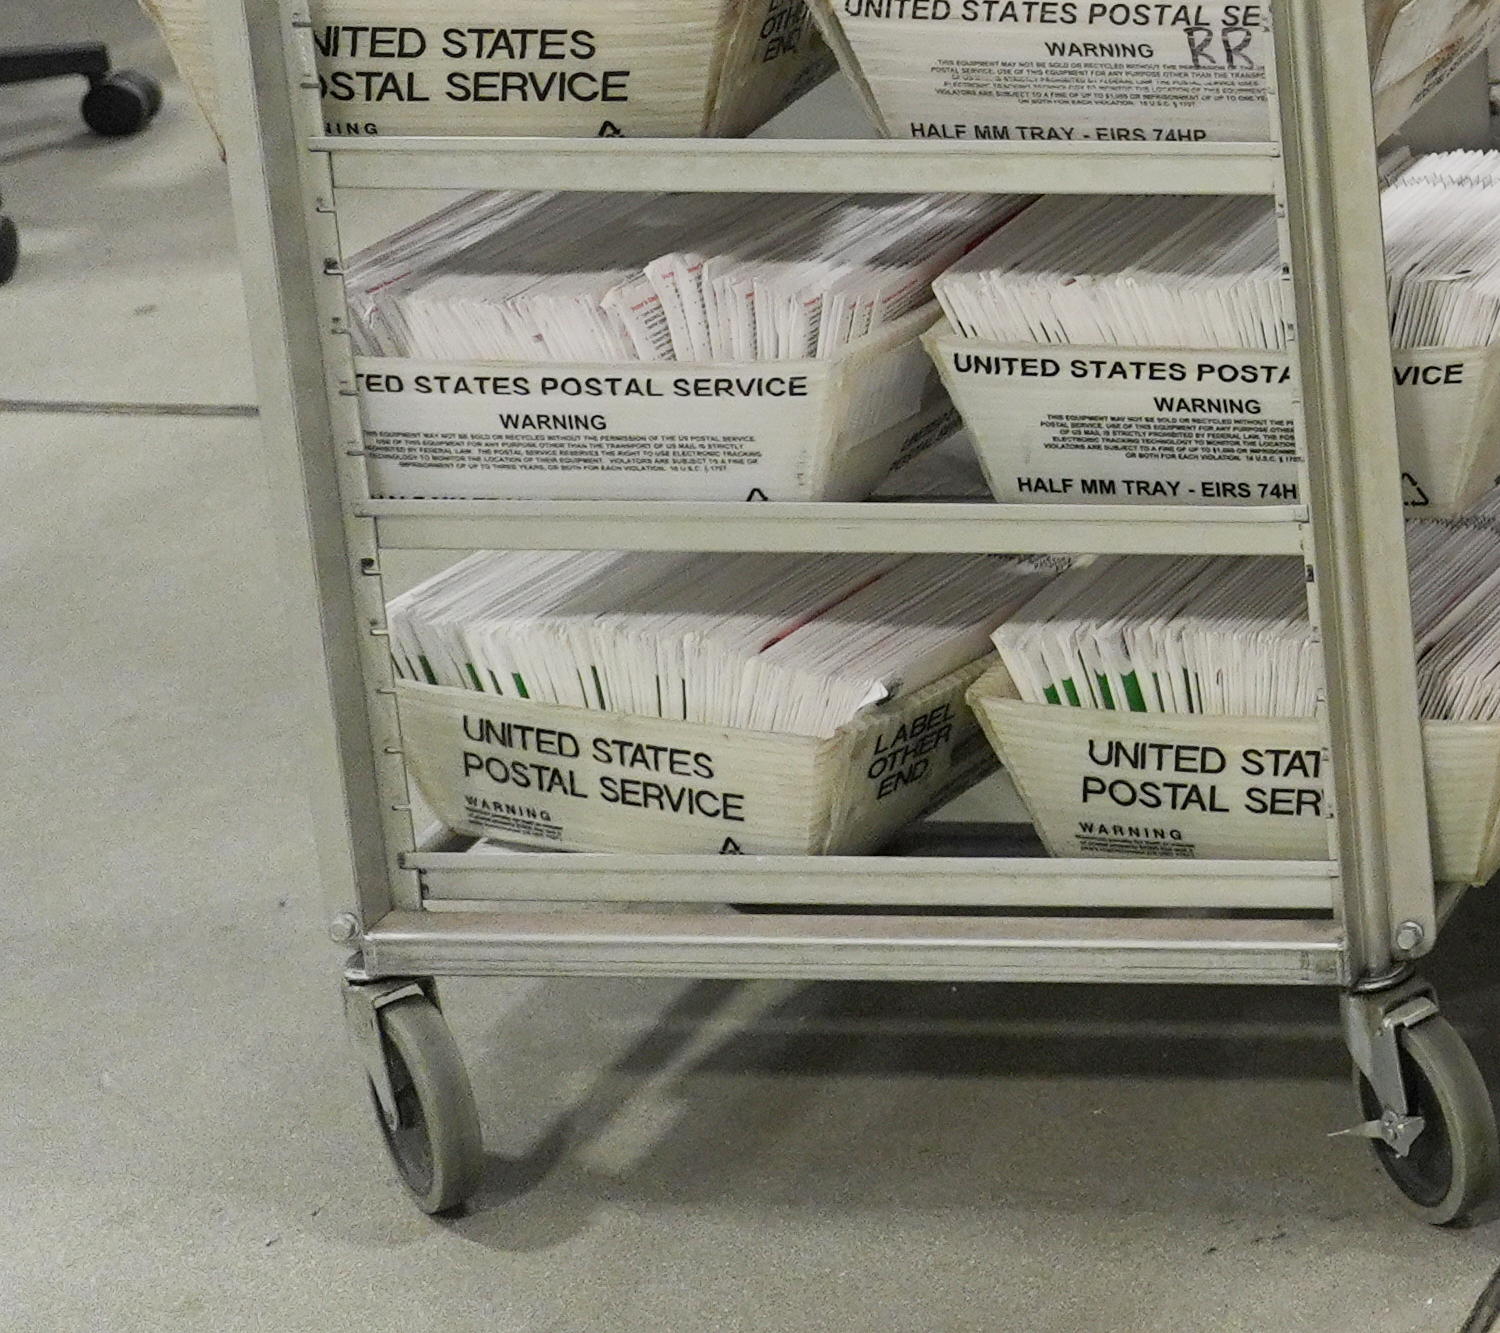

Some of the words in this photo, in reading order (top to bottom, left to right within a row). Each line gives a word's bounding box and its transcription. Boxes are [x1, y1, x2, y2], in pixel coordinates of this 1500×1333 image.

[960, 0, 1078, 25] STATES
[1088, 3, 1211, 27] POSTAL
[442, 28, 596, 60] STATES
[1044, 41, 1154, 59] WARNING
[445, 70, 631, 102] SERVICE
[414, 375, 531, 396] STATES
[541, 377, 664, 397] POSTAL
[673, 376, 808, 397] SERVICE
[953, 352, 1061, 377] UNITED
[1070, 359, 1187, 382] STATES
[1196, 363, 1291, 384] POSTA
[1392, 363, 1464, 387] VICE
[498, 413, 607, 431] WARNING
[1153, 396, 1262, 415] WARNING
[1017, 476, 1074, 494] HALF
[1080, 478, 1117, 495] MM
[1121, 479, 1181, 497] TRAY
[1201, 481, 1251, 499] EIRS
[873, 701, 956, 756] LABEL
[462, 714, 580, 768] UNITED
[592, 737, 715, 779] STATES
[867, 722, 953, 780] OTHER
[1088, 739, 1227, 774] UNITED
[1240, 748, 1321, 779] STAT
[463, 750, 589, 807] POSTAL
[599, 775, 745, 822] SERVICE
[875, 758, 929, 801] END
[1082, 775, 1230, 813] POSTAL
[464, 794, 552, 828] WARNING
[1078, 821, 1183, 841] WARNING
